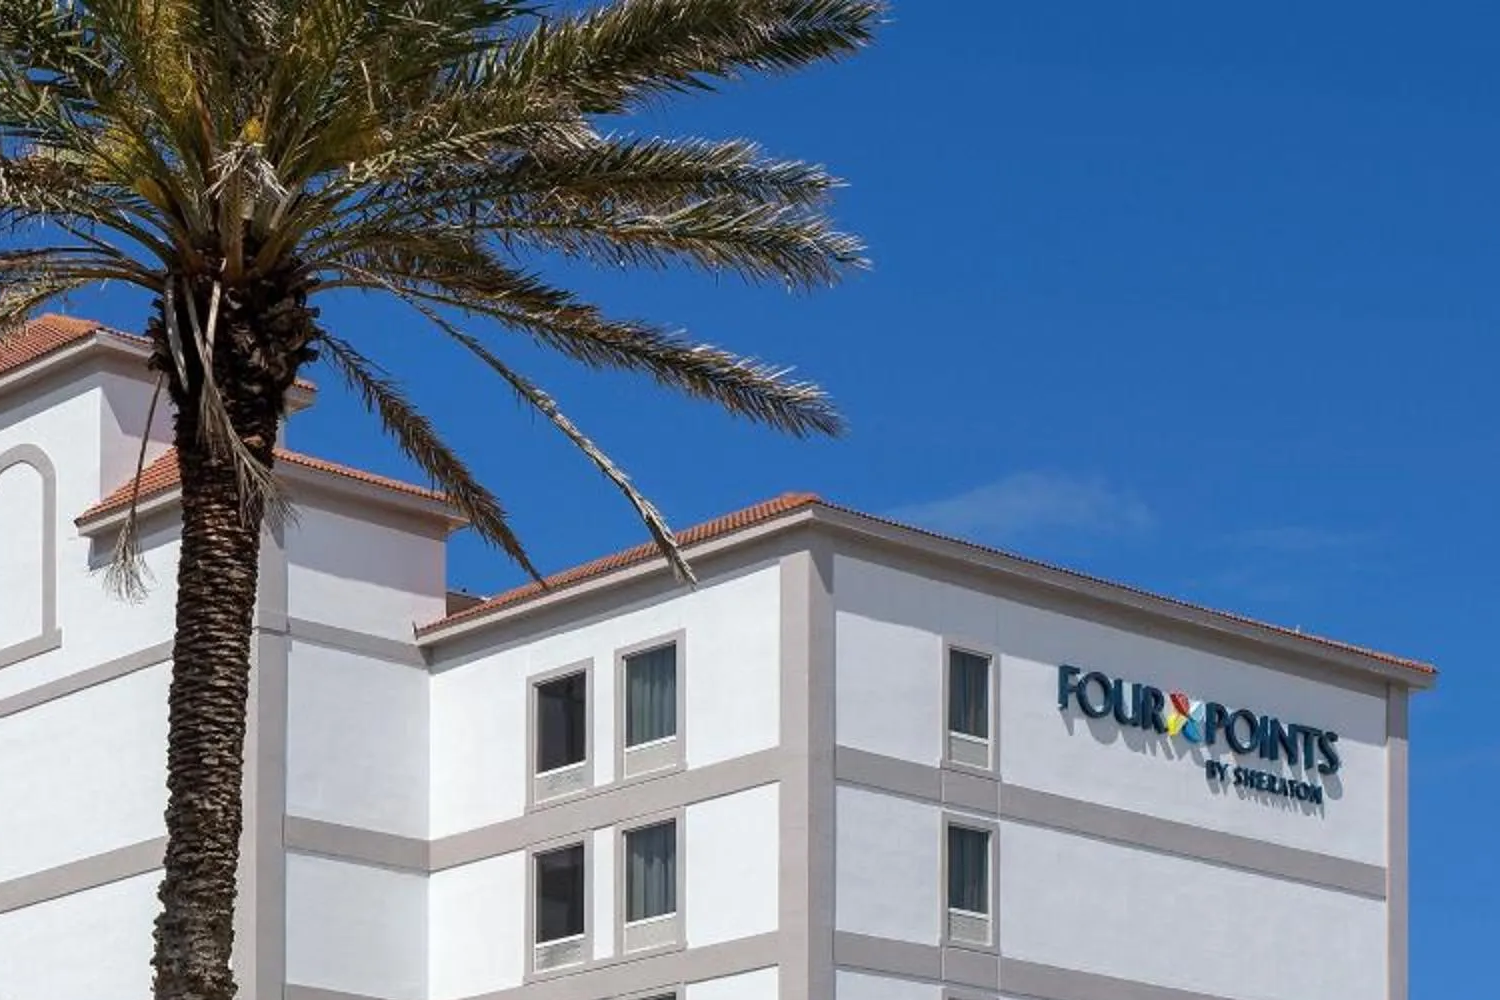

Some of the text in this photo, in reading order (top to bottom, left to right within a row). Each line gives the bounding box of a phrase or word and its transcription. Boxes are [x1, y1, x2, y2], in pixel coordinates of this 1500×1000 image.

[1057, 664, 1341, 775] FOUR POINTS
[1206, 759, 1323, 804] BY SHERATON
